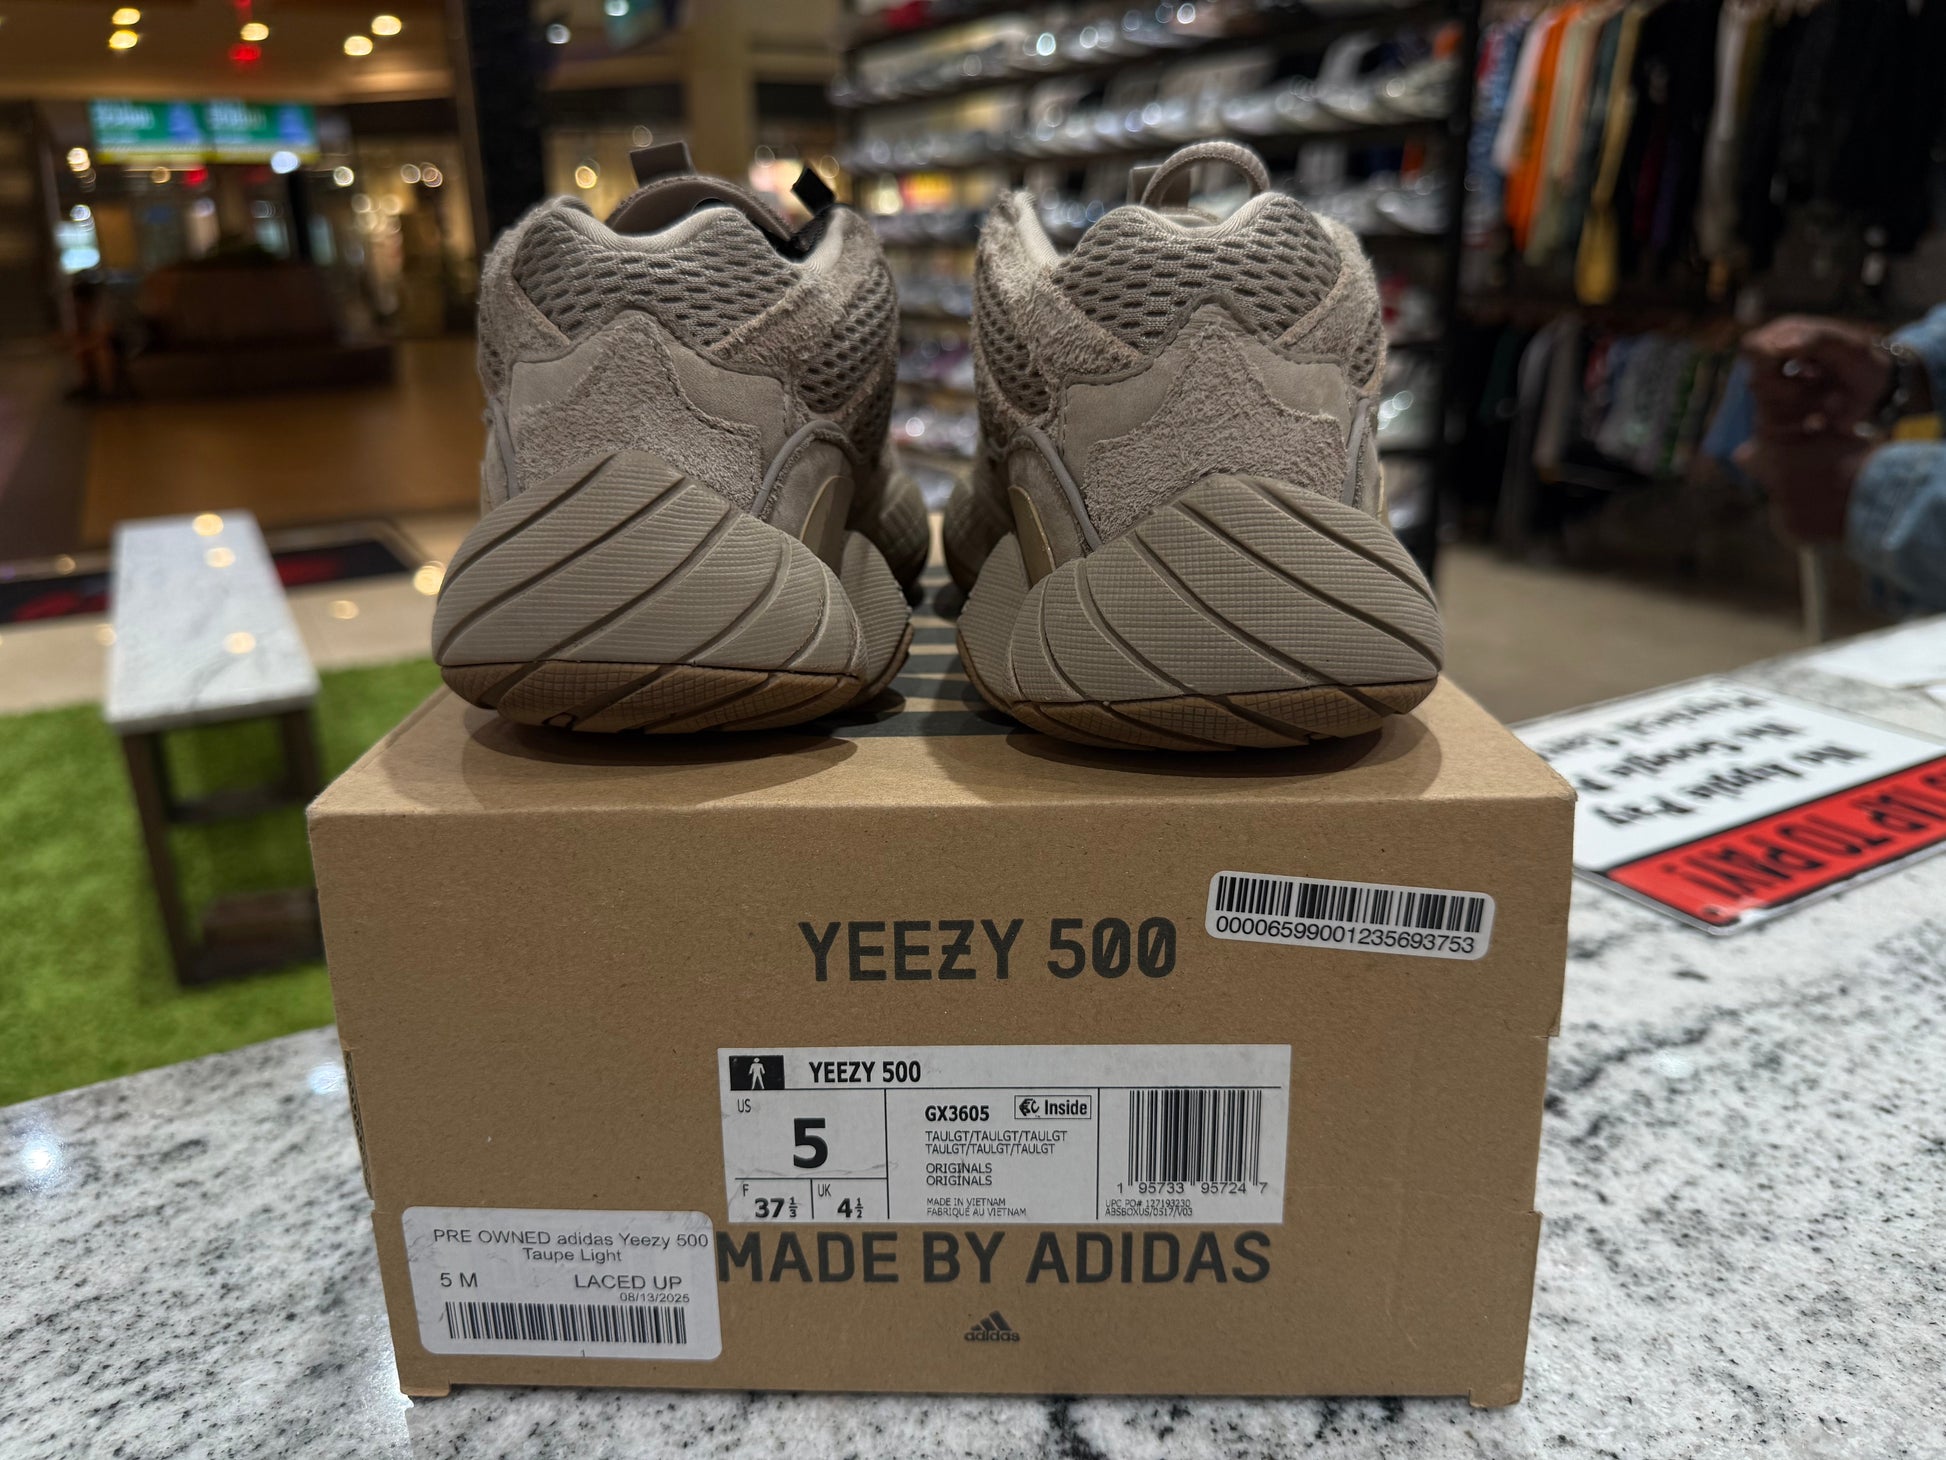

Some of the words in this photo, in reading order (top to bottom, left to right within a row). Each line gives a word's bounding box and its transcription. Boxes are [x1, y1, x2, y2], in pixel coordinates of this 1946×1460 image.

[1215, 915, 1475, 954] 00006599001235693753
[798, 918, 1024, 982] YEEZY
[1046, 916, 1177, 979] 500
[808, 1061, 876, 1083] YEEZY
[882, 1060, 922, 1084] 500
[737, 1098, 752, 1113] US
[924, 1104, 990, 1122] GX3605
[1044, 1099, 1088, 1116] Inside
[793, 1117, 829, 1169] 5
[925, 1130, 1068, 1146] TAULGT/TAULGT/TAULGT
[925, 1143, 1056, 1156] TAULGT/TAULGT/TAULGT
[925, 1162, 993, 1174] ORIGINALS
[925, 1175, 993, 1187] ORIGINALS
[1116, 1182, 1124, 1194] 1
[1138, 1182, 1185, 1194] 95733
[1200, 1182, 1247, 1194] 95724
[1259, 1182, 1268, 1194] 7
[742, 1183, 750, 1197] F
[817, 1183, 832, 1198] UK
[926, 1197, 951, 1207] MADE
[954, 1197, 964, 1207] IN
[966, 1197, 1006, 1207] VIETNAM
[972, 1207, 985, 1217] AU
[987, 1207, 1027, 1217] VIETNAM
[433, 1229, 472, 1244] PRE
[478, 1229, 551, 1245] OWNED
[556, 1231, 614, 1247] adidas
[618, 1233, 671, 1250] Yeezy
[676, 1233, 709, 1248] 500
[522, 1247, 575, 1263] Taupe
[580, 1248, 622, 1264] Light
[716, 1230, 899, 1283] MADE
[921, 1230, 1006, 1283] BY
[1025, 1230, 1271, 1284] ADIDAS
[440, 1272, 453, 1288] 5
[460, 1272, 478, 1288] M
[575, 1273, 646, 1290] LACED
[653, 1275, 683, 1290] UP
[619, 1292, 690, 1304] 08/13/2025
[964, 1329, 1021, 1341] adidas
